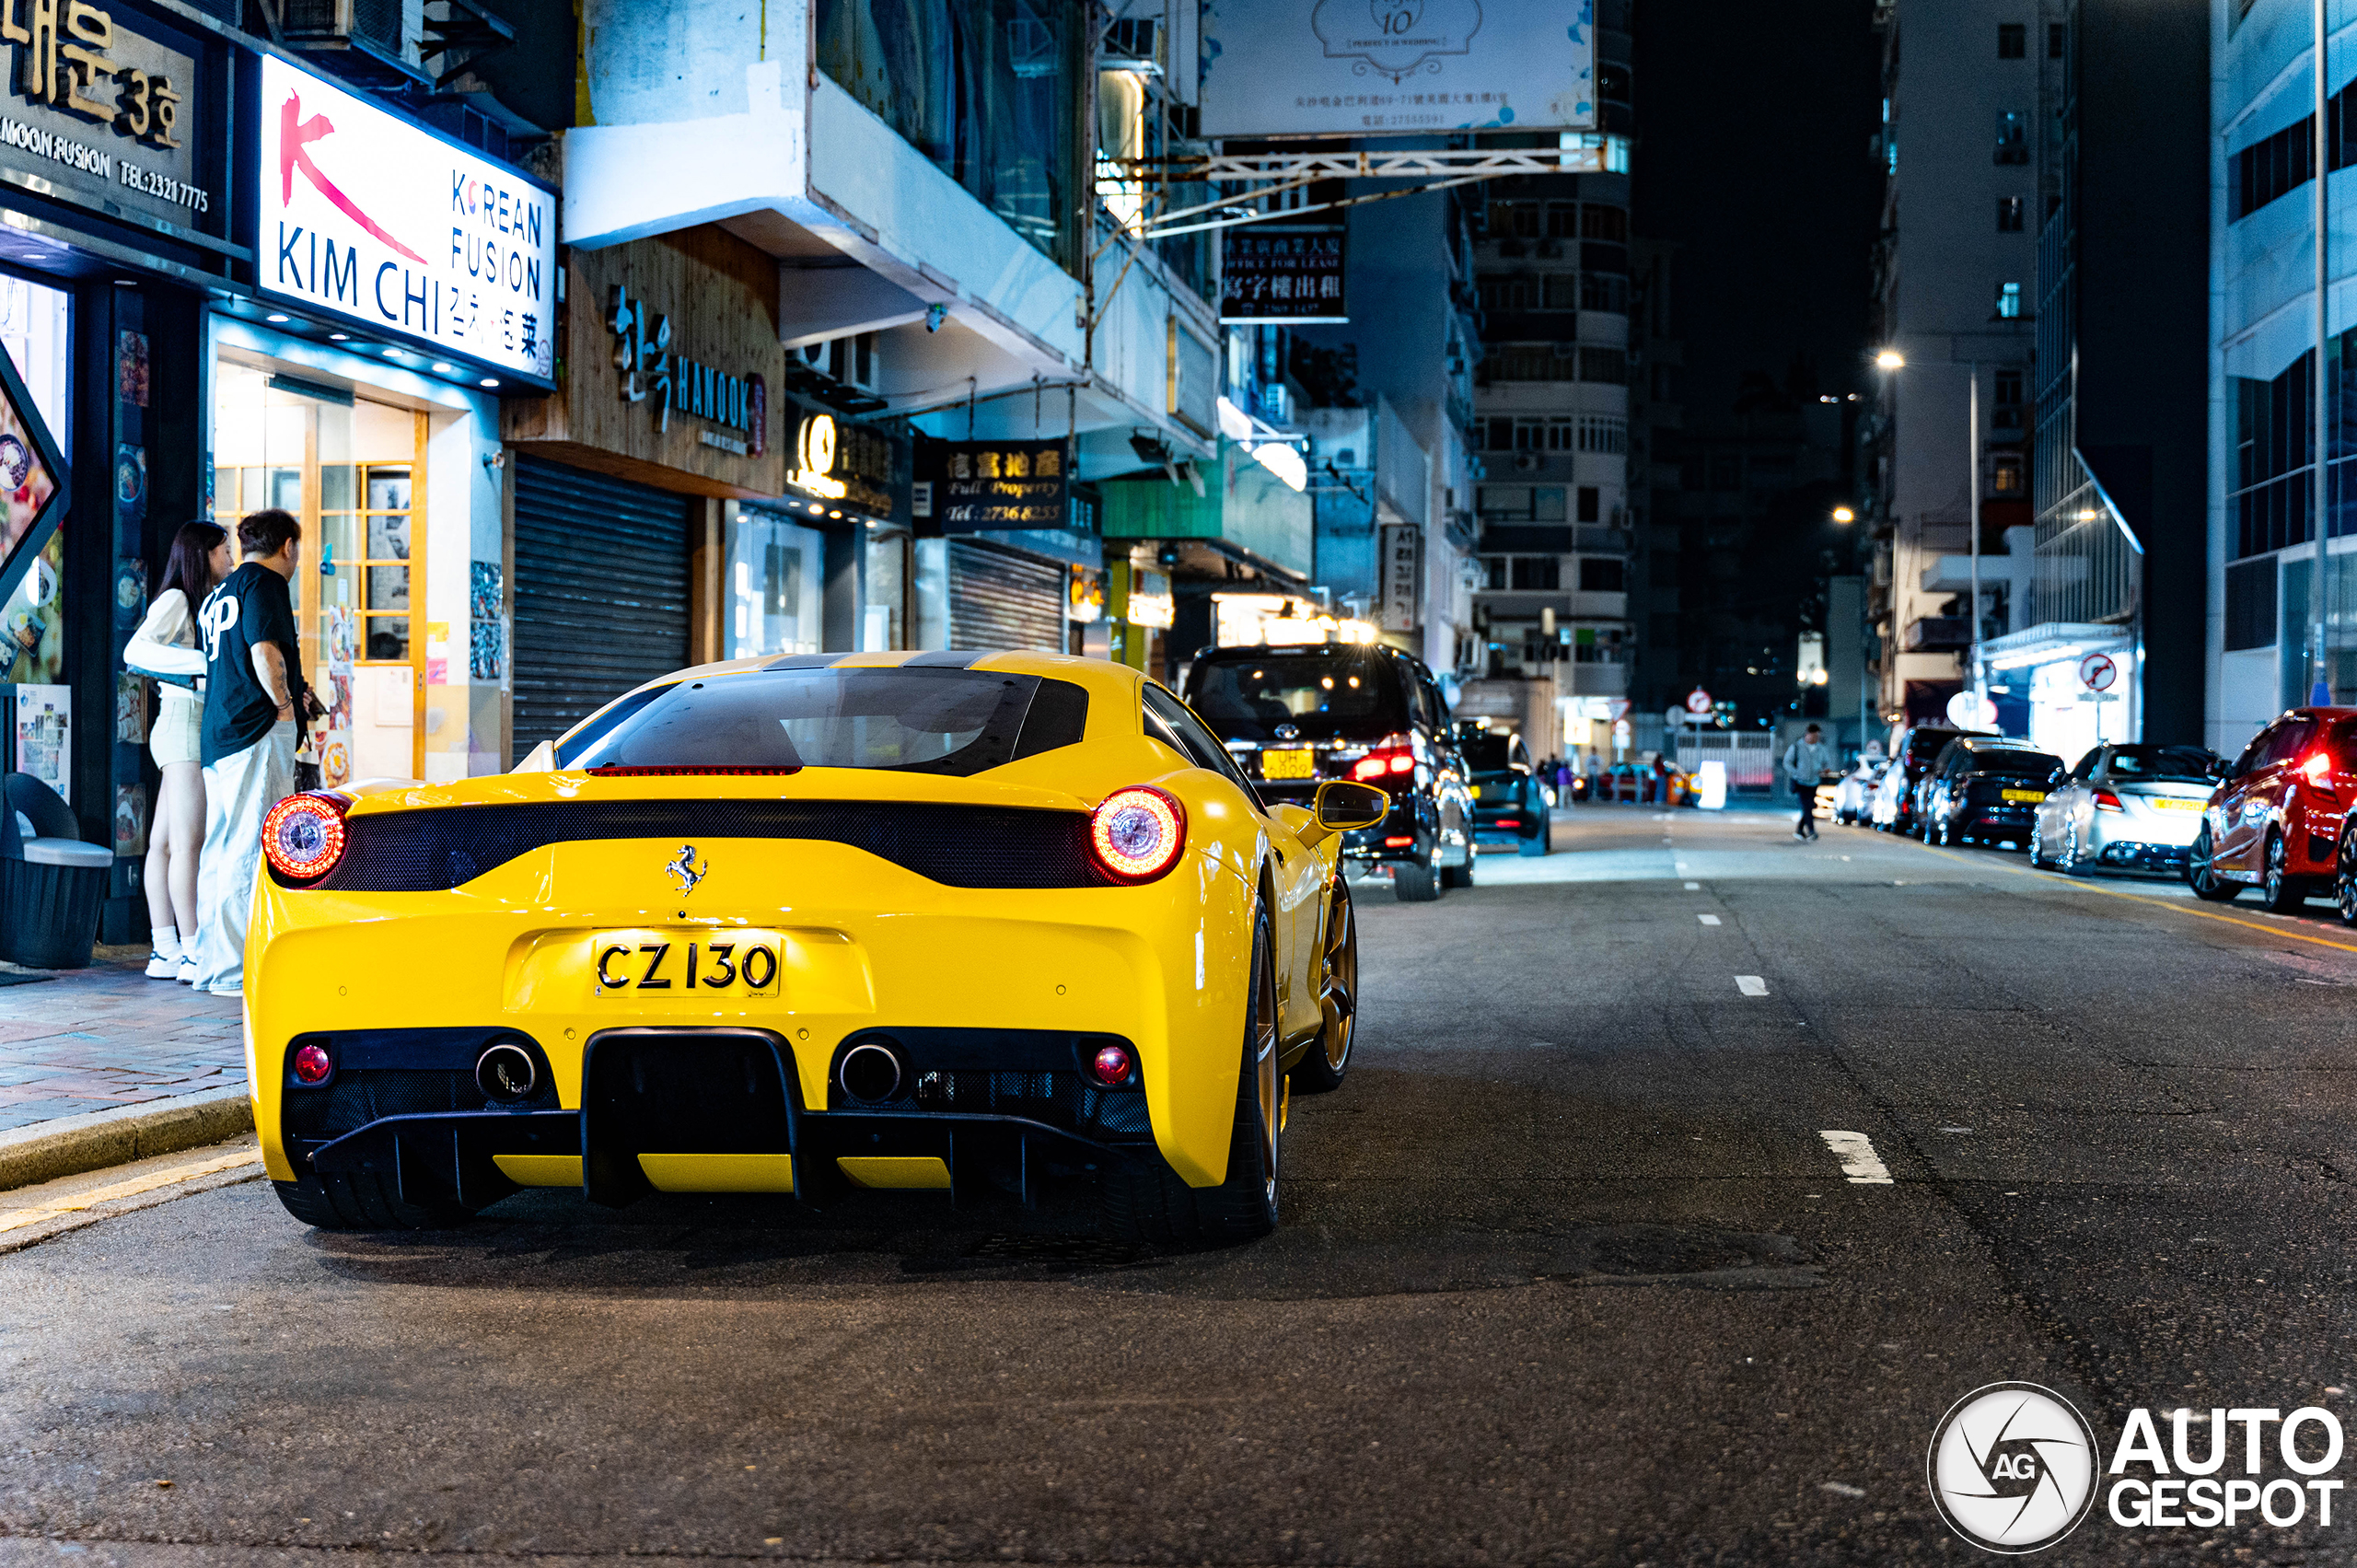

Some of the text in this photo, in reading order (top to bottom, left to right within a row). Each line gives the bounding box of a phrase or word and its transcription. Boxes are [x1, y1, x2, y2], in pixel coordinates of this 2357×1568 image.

[0, 116, 52, 159] MOON
[54, 135, 110, 179] FUSION
[452, 168, 541, 249] KOREAN
[279, 220, 438, 335] KIM CHI
[451, 226, 540, 301] FUSION
[678, 355, 749, 432] HANOOK
[947, 480, 982, 495] Full
[989, 480, 1059, 499] Property
[1269, 763, 1307, 776] 6809
[598, 943, 776, 989] CZ 130
